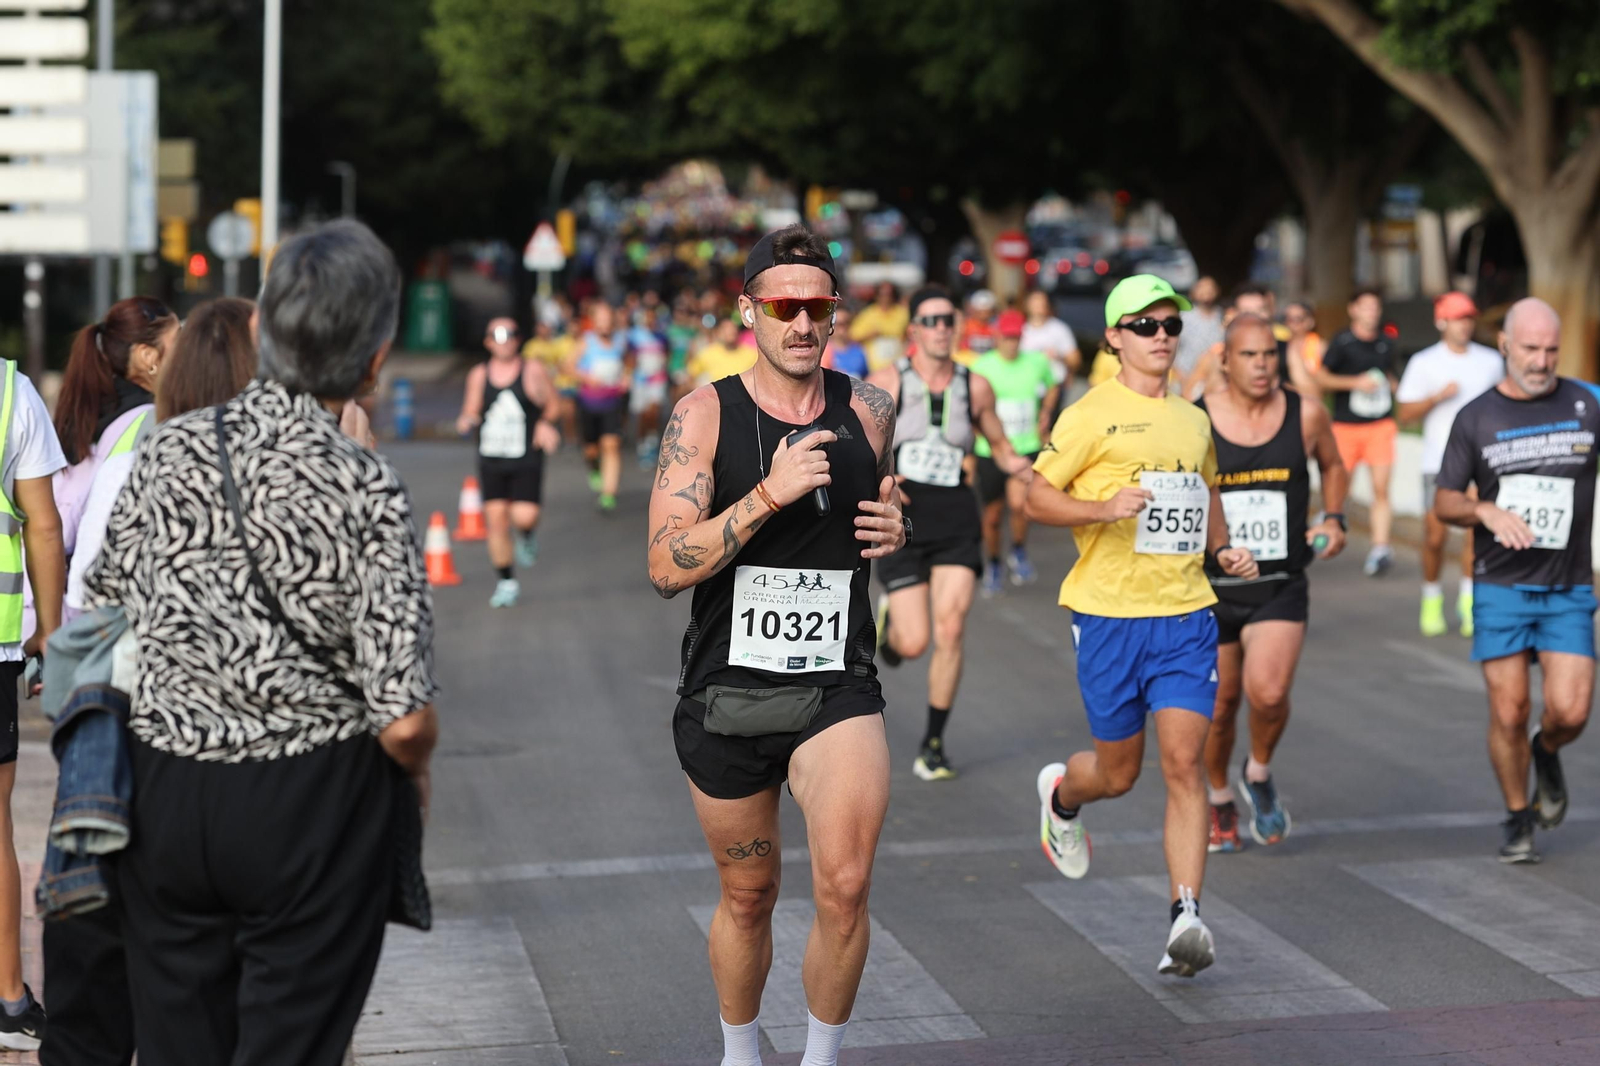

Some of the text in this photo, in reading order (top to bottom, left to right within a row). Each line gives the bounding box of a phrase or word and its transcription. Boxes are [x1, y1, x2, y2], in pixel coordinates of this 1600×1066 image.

[1147, 507, 1204, 533] 5552
[753, 573, 788, 589] 45
[743, 591, 792, 599] CARRERA
[743, 596, 792, 605] URBANA
[740, 607, 841, 642] 10321
